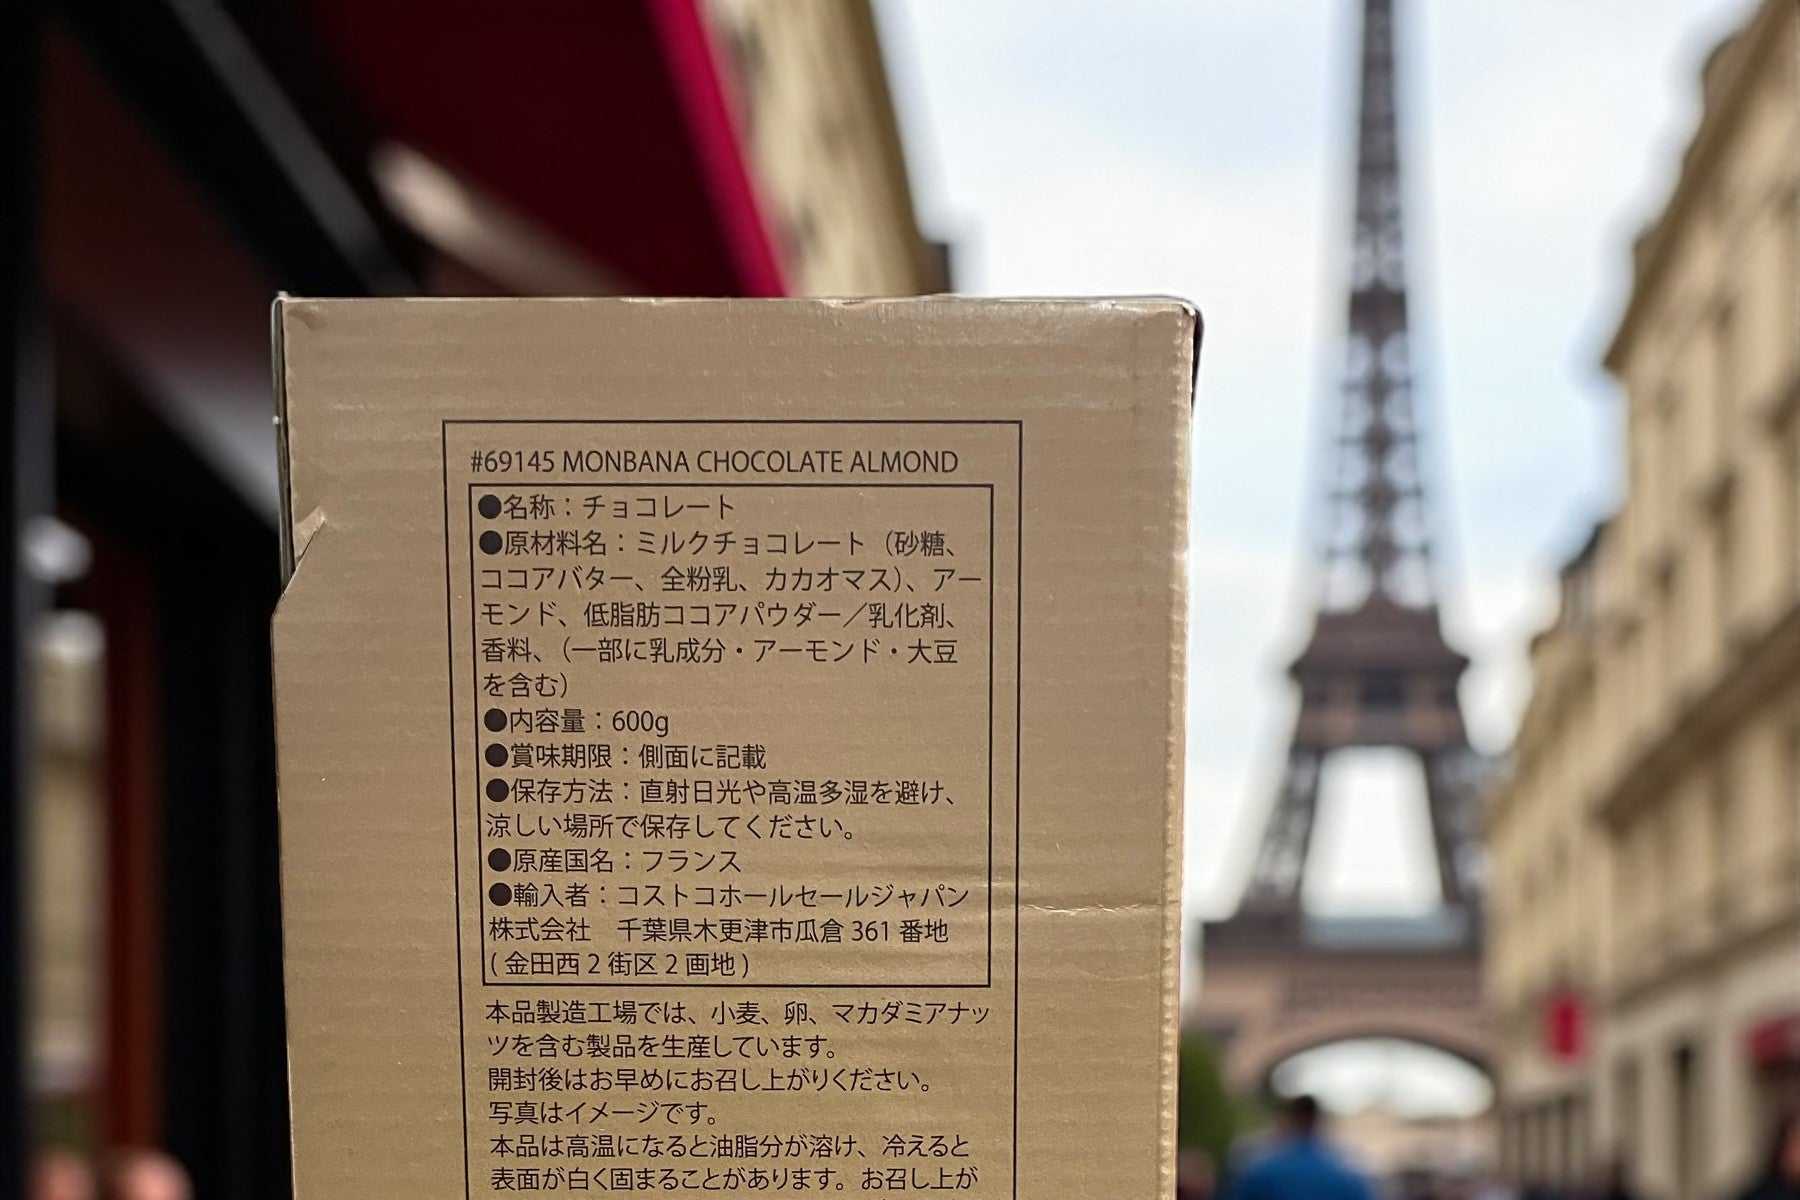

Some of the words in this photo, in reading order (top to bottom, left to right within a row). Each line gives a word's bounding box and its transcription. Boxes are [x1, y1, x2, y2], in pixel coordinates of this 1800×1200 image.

[471, 450, 554, 473] #69145
[563, 450, 690, 473] MONBANA
[697, 450, 843, 473] CHOCOLATE
[850, 450, 958, 473] ALMOND
[486, 812, 853, 841] 涼しい場所で保存してください。
[488, 916, 592, 943] 株式会社
[488, 1033, 835, 1061] ツを含む製品を生産しています。
[488, 1067, 930, 1094] 開封後はお早めにお召し上がりください。
[489, 1100, 720, 1128] 写真はイメージです。
